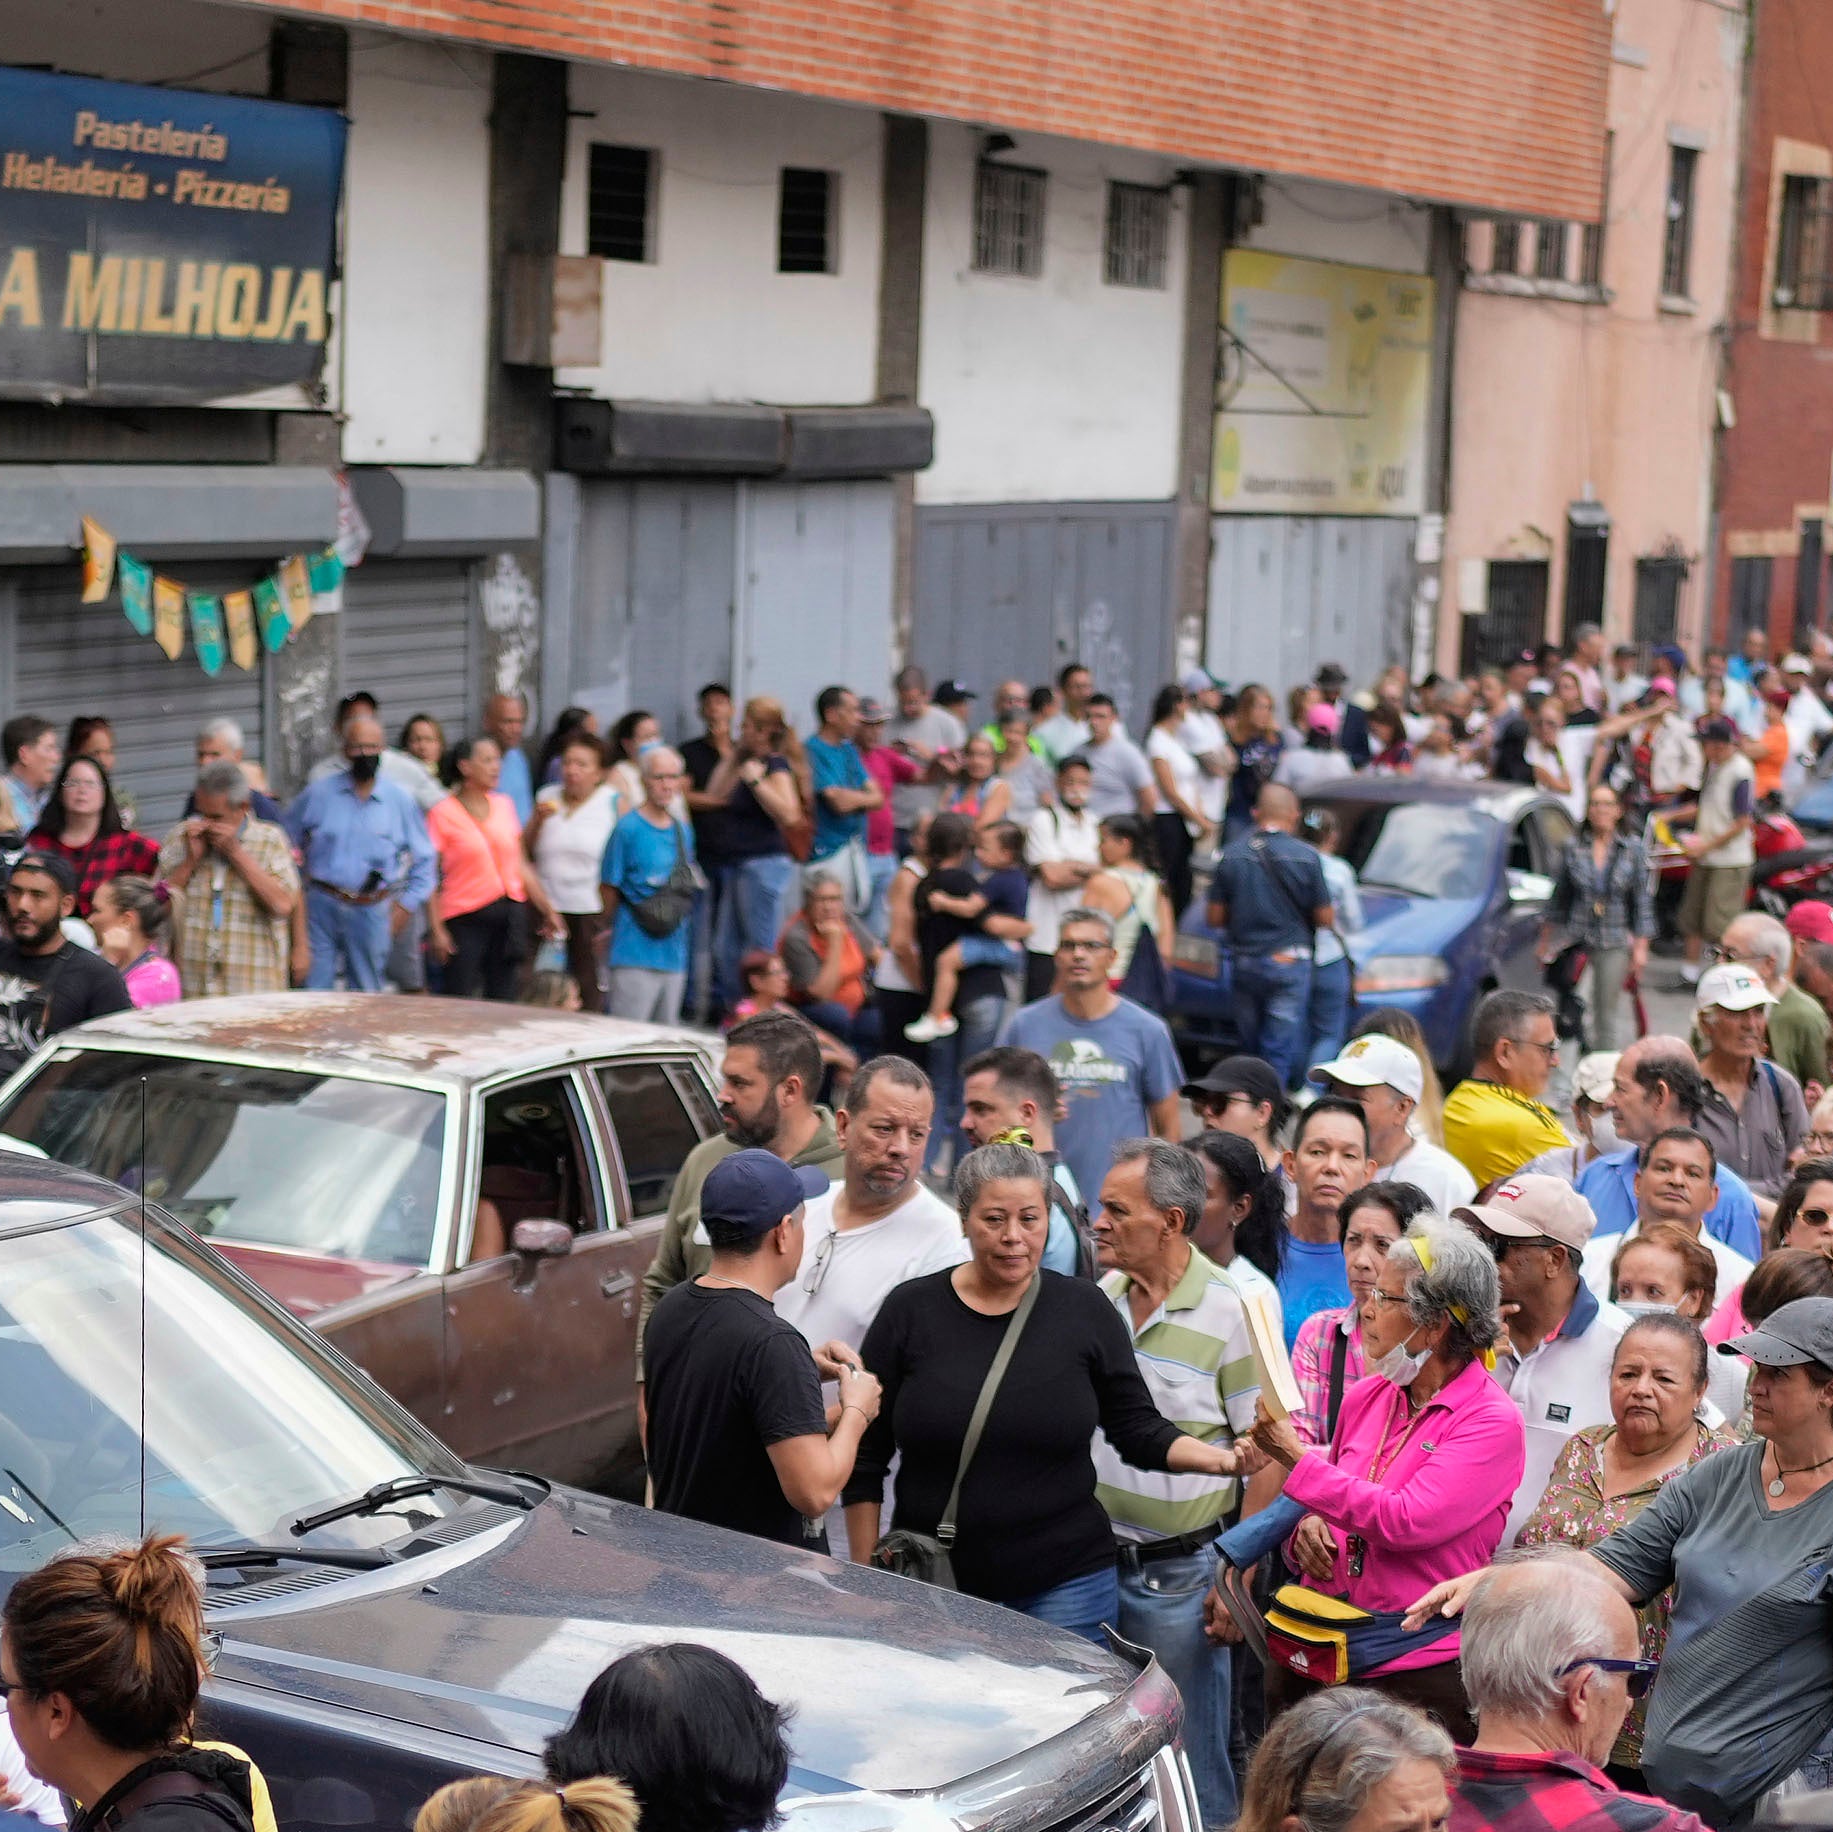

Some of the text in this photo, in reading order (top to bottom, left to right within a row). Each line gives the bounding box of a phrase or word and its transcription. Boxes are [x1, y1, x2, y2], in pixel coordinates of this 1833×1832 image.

[74, 110, 229, 162] Pastelería
[2, 153, 146, 200] Heladería
[174, 169, 291, 213] Pizzería
[65, 251, 328, 342] MILHOJA
